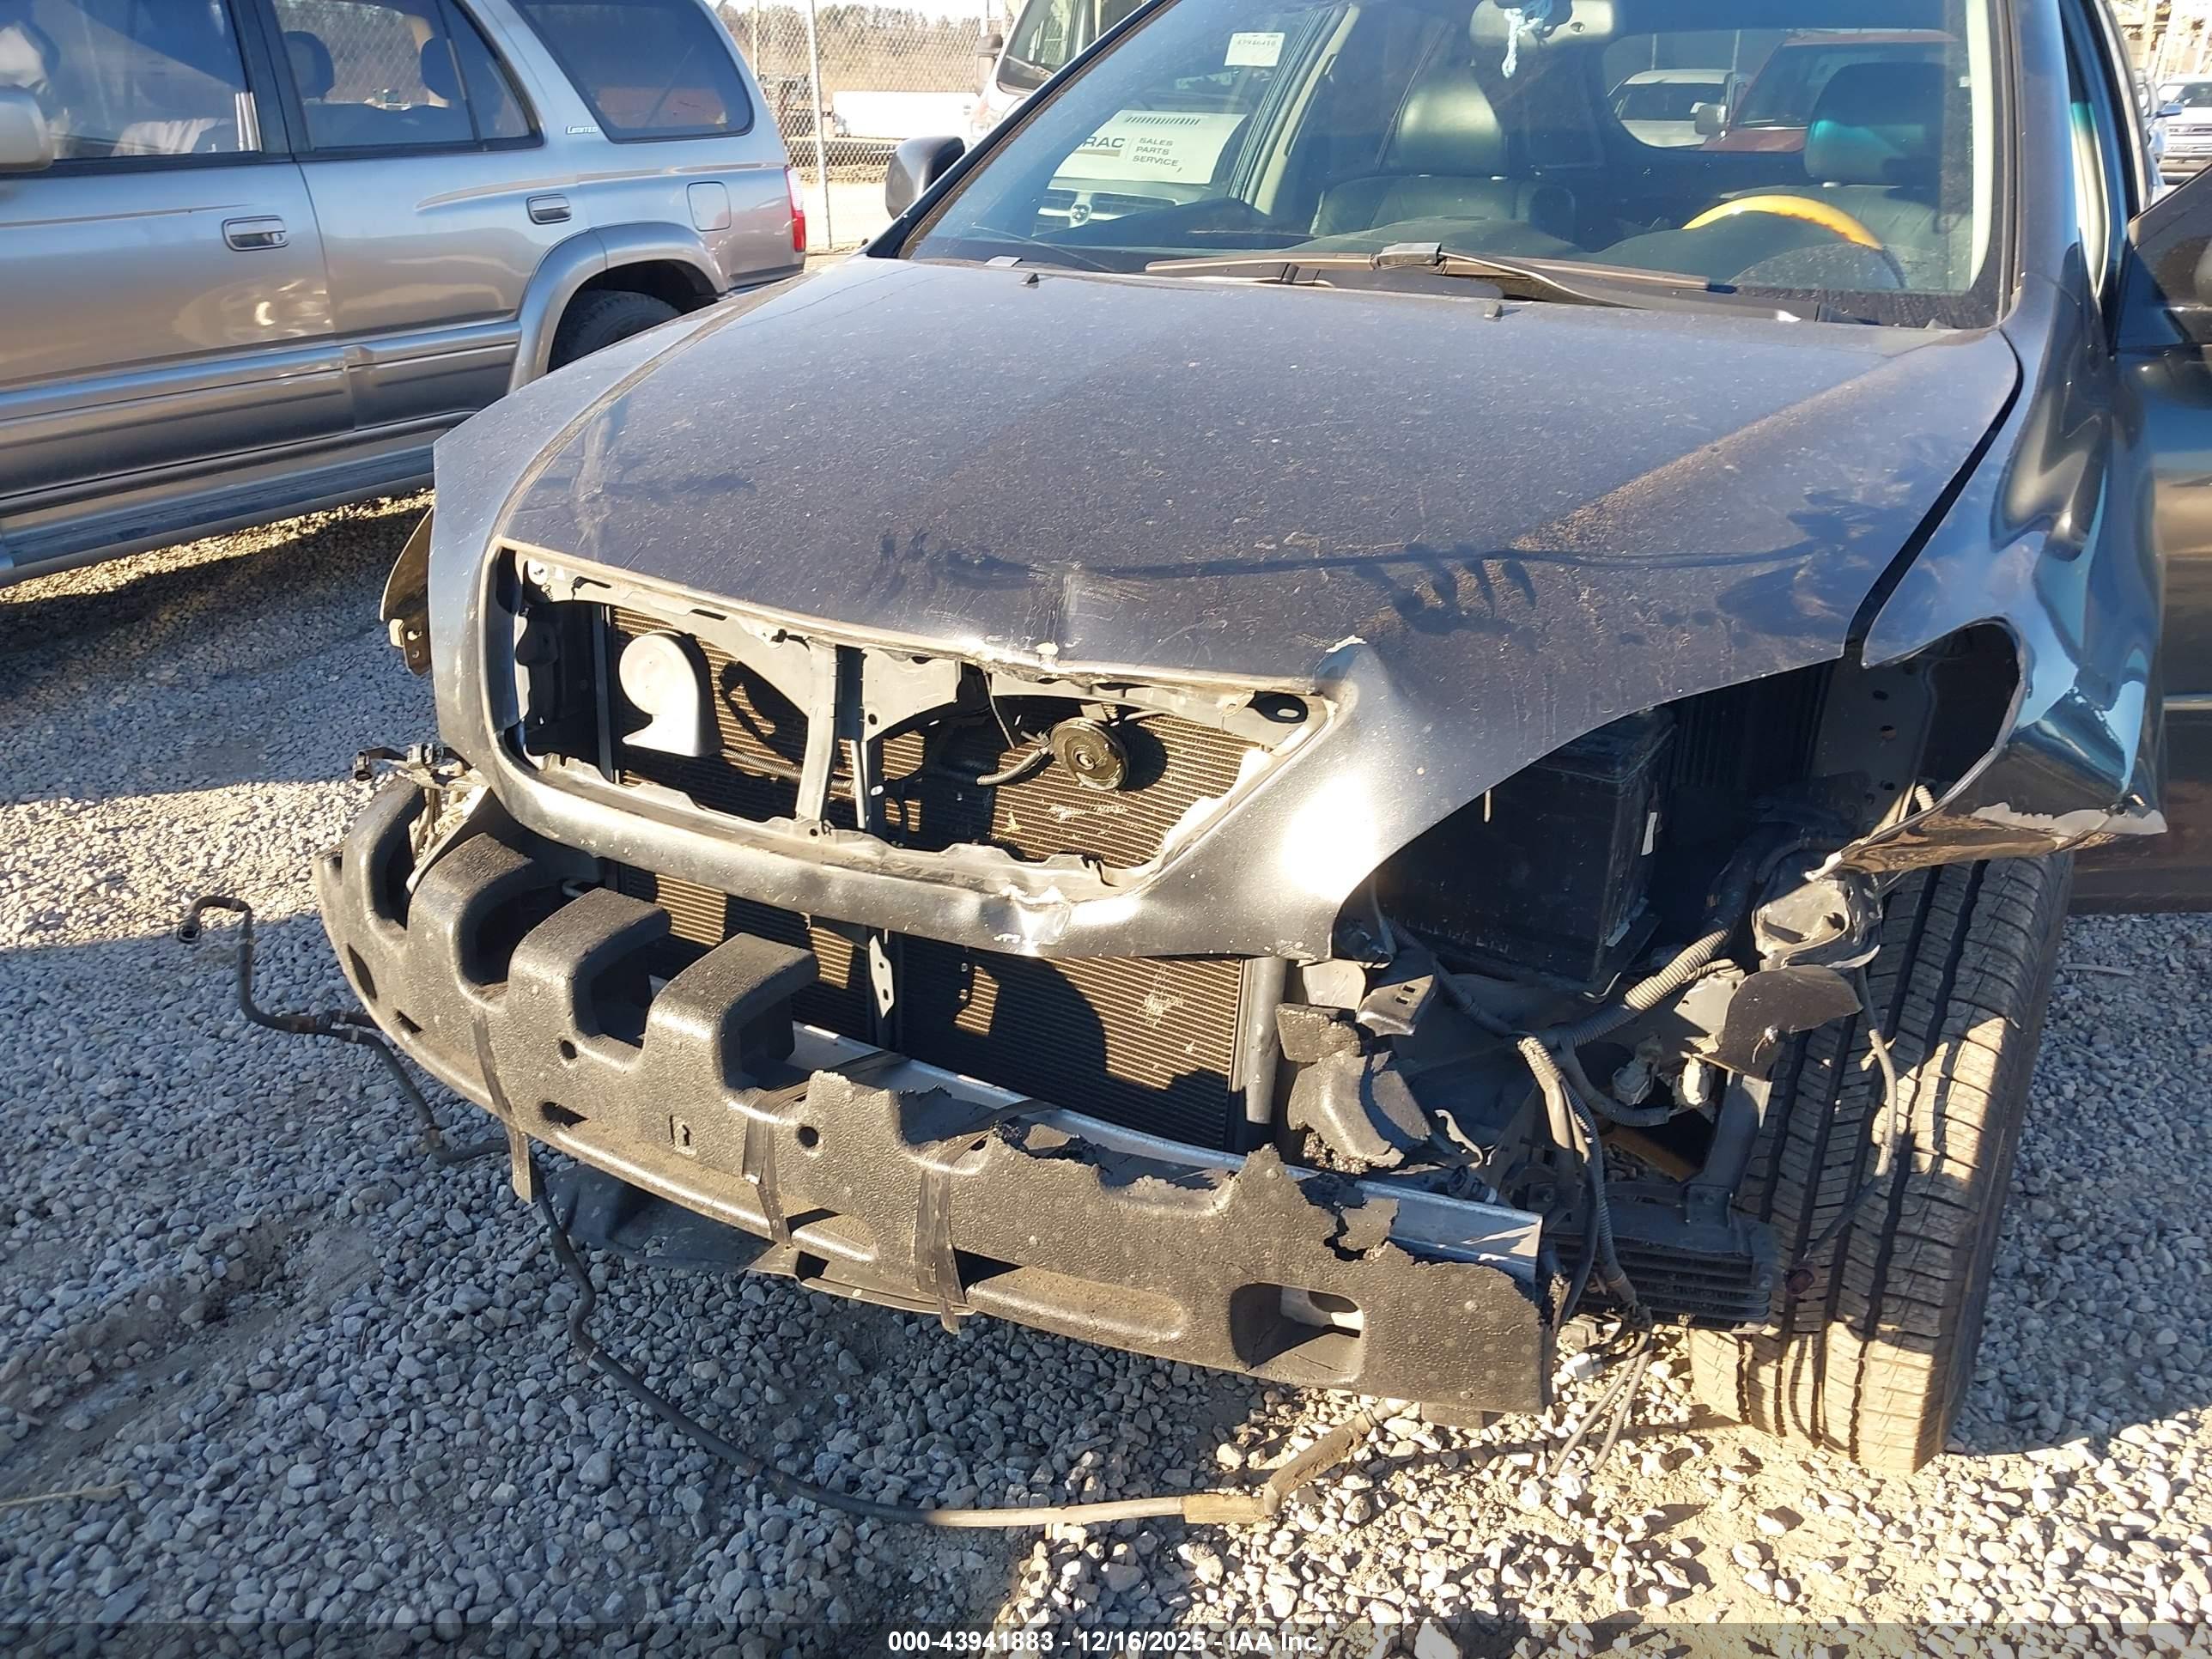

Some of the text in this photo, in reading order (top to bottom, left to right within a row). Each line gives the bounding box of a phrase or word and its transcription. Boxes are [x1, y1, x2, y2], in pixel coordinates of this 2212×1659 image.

[1139, 137, 1174, 147] SALES
[1135, 146, 1170, 155] PARTS
[1133, 155, 1179, 167] SERVICE
